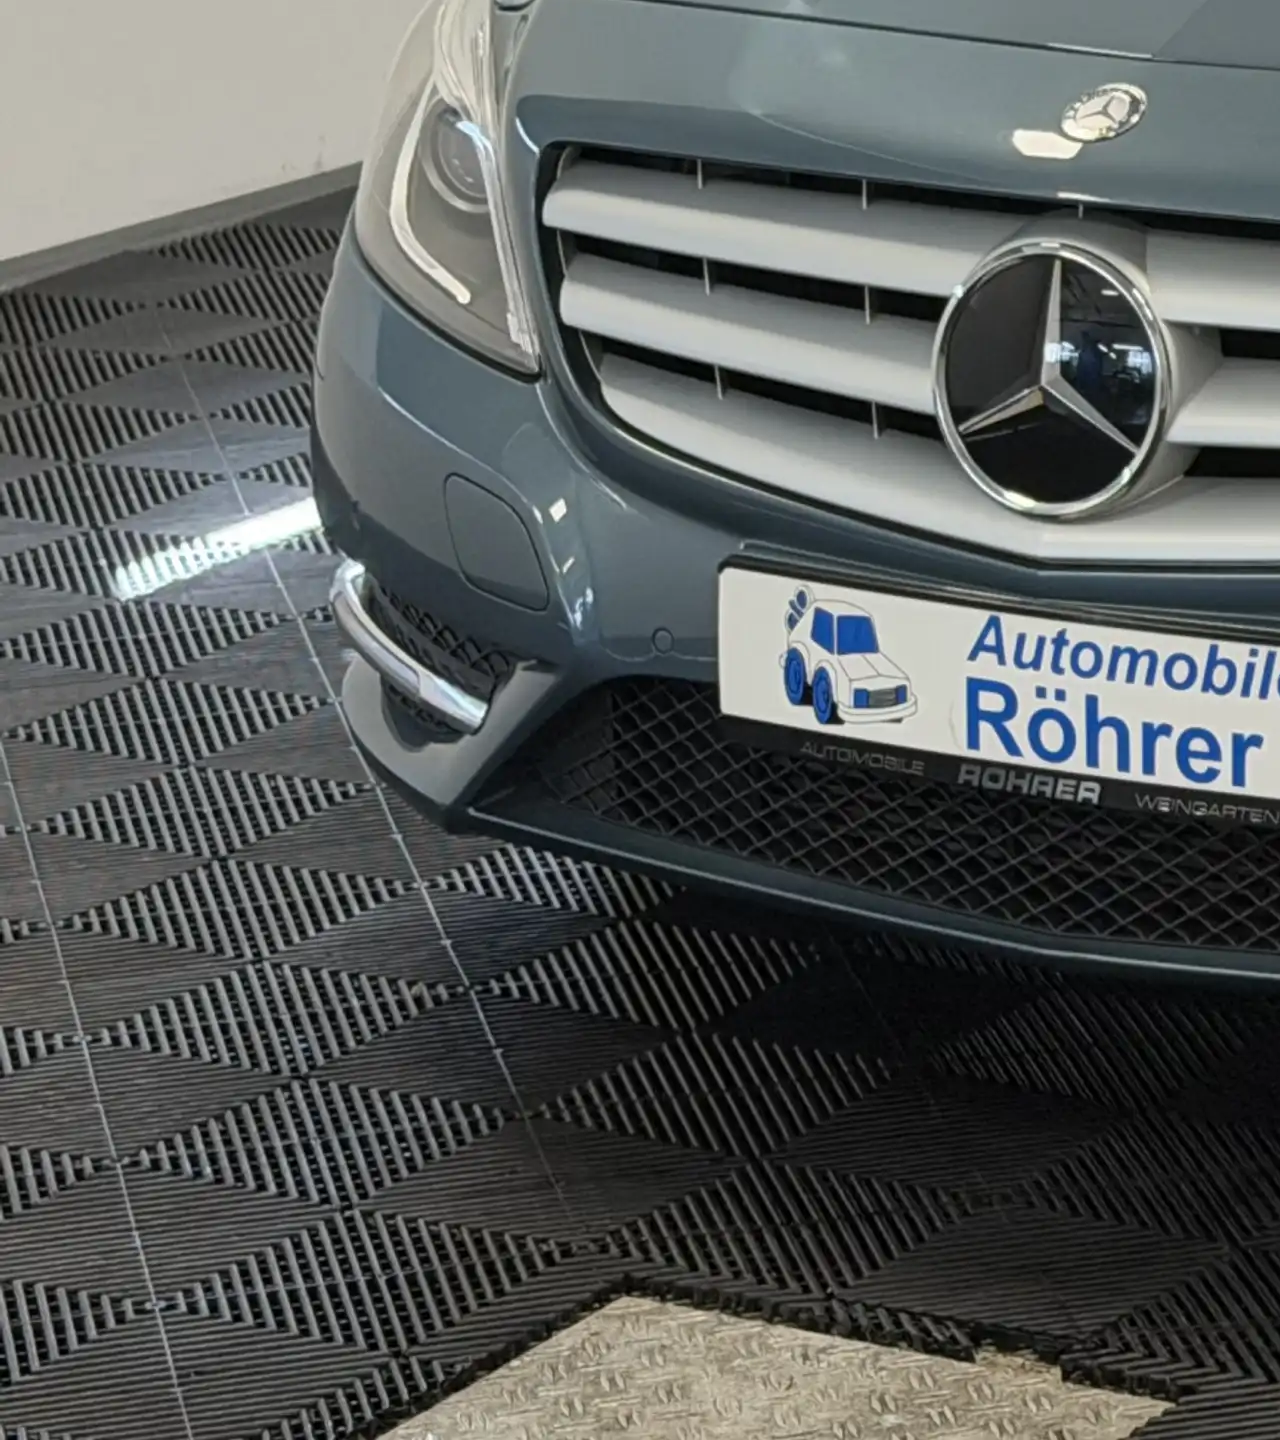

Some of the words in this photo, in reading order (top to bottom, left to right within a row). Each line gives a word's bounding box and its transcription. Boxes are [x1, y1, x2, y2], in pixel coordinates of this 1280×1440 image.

[965, 677, 1264, 789] Röhrer
[800, 741, 925, 776] AUTOMOBILE
[1134, 792, 1280, 825] WEINGARTEN
